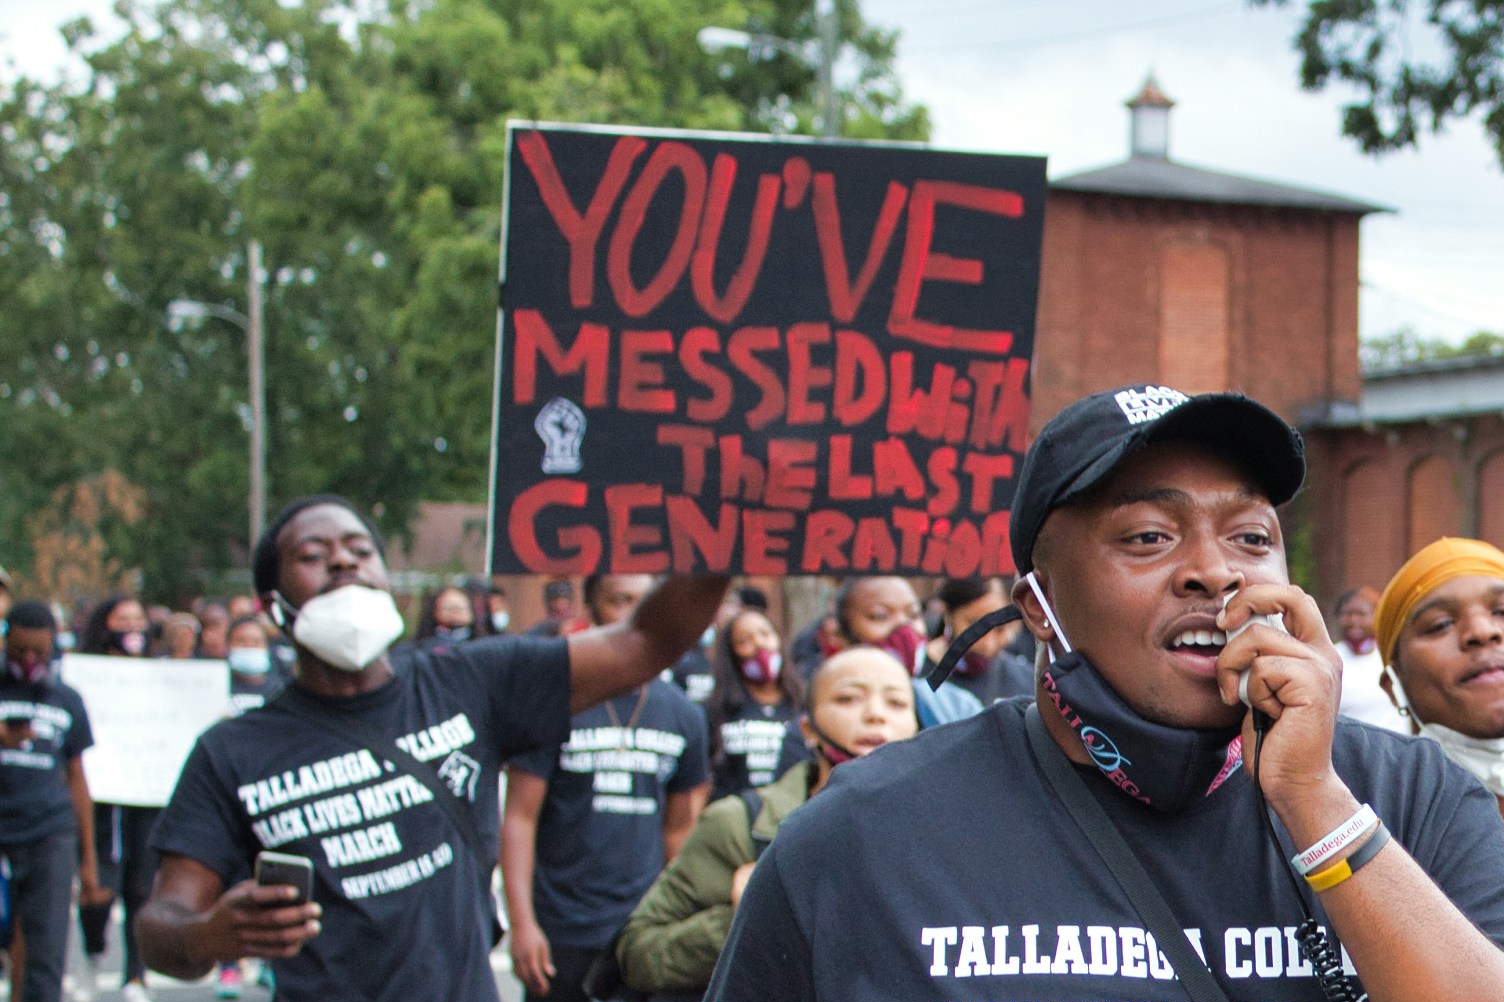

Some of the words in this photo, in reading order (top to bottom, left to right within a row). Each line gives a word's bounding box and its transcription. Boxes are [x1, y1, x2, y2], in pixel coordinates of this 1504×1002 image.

[517, 130, 1025, 353] YOU'VE
[513, 308, 886, 431] MESSED
[829, 433, 1013, 517] LAST
[238, 749, 382, 816] TALLADEGA
[303, 793, 362, 834] LIVES
[321, 821, 402, 868] MARCH
[1300, 818, 1364, 867] Talladega.edu
